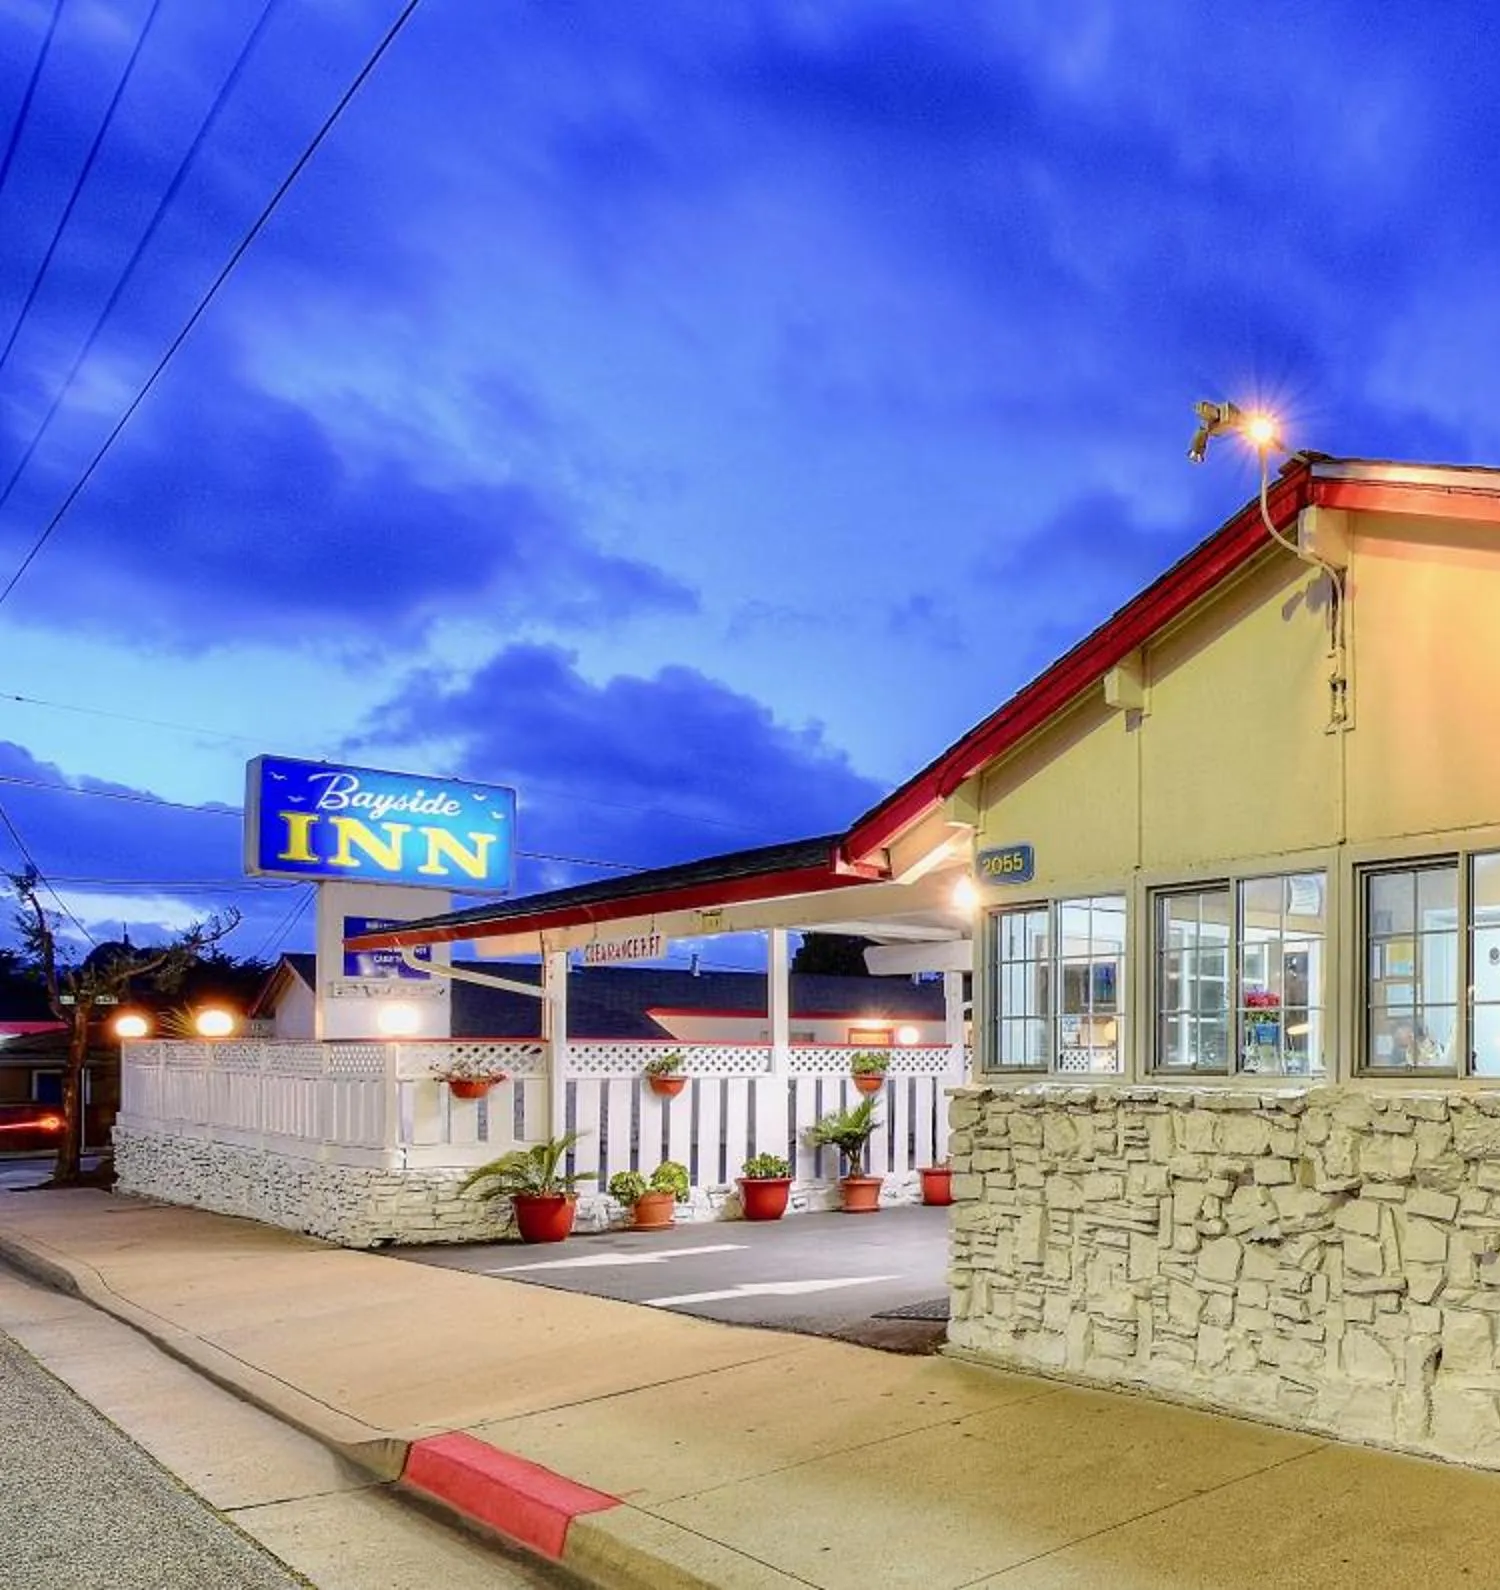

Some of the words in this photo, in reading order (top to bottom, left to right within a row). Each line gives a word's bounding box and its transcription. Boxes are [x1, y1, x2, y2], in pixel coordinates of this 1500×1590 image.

[308, 772, 461, 819] Bayside
[278, 812, 496, 878] INN
[982, 852, 1023, 874] 2055
[584, 938, 639, 962] CLEARANCE
